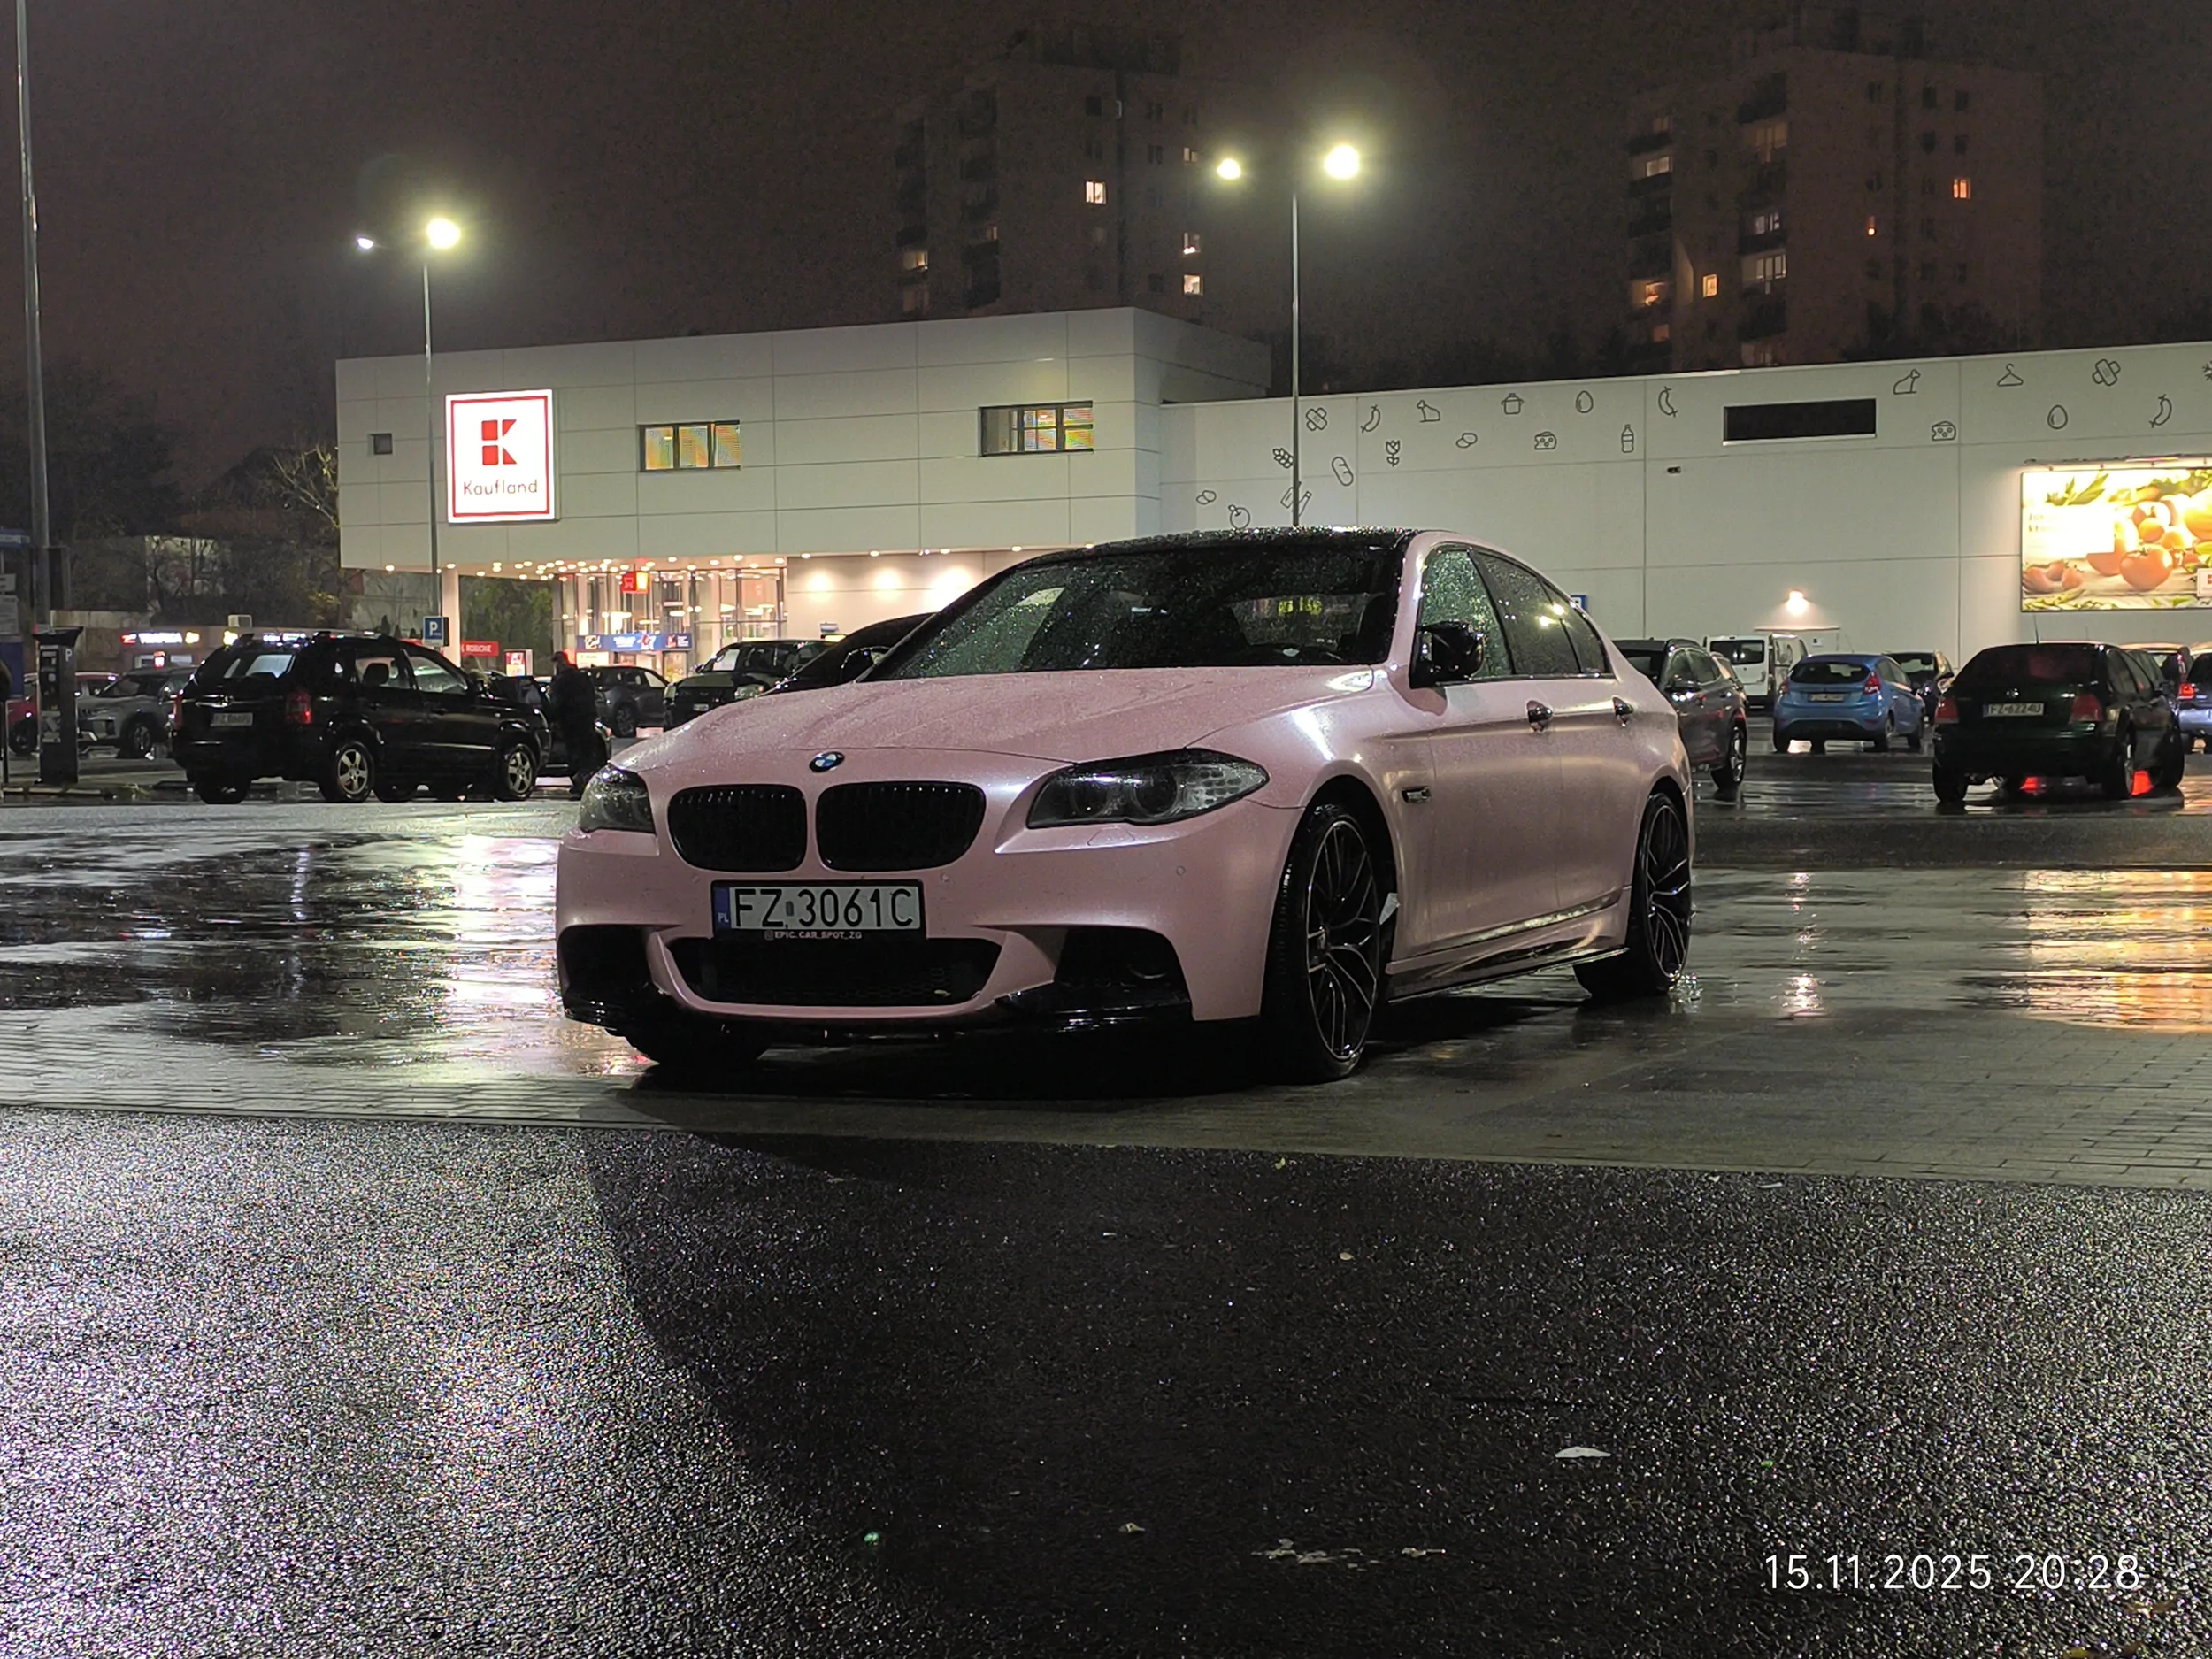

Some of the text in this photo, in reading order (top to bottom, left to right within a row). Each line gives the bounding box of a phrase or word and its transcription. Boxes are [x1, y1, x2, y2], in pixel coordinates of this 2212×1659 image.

[463, 479, 538, 495] Kaufland
[429, 621, 438, 636] P
[65, 648, 73, 662] P
[718, 912, 729, 923] PL
